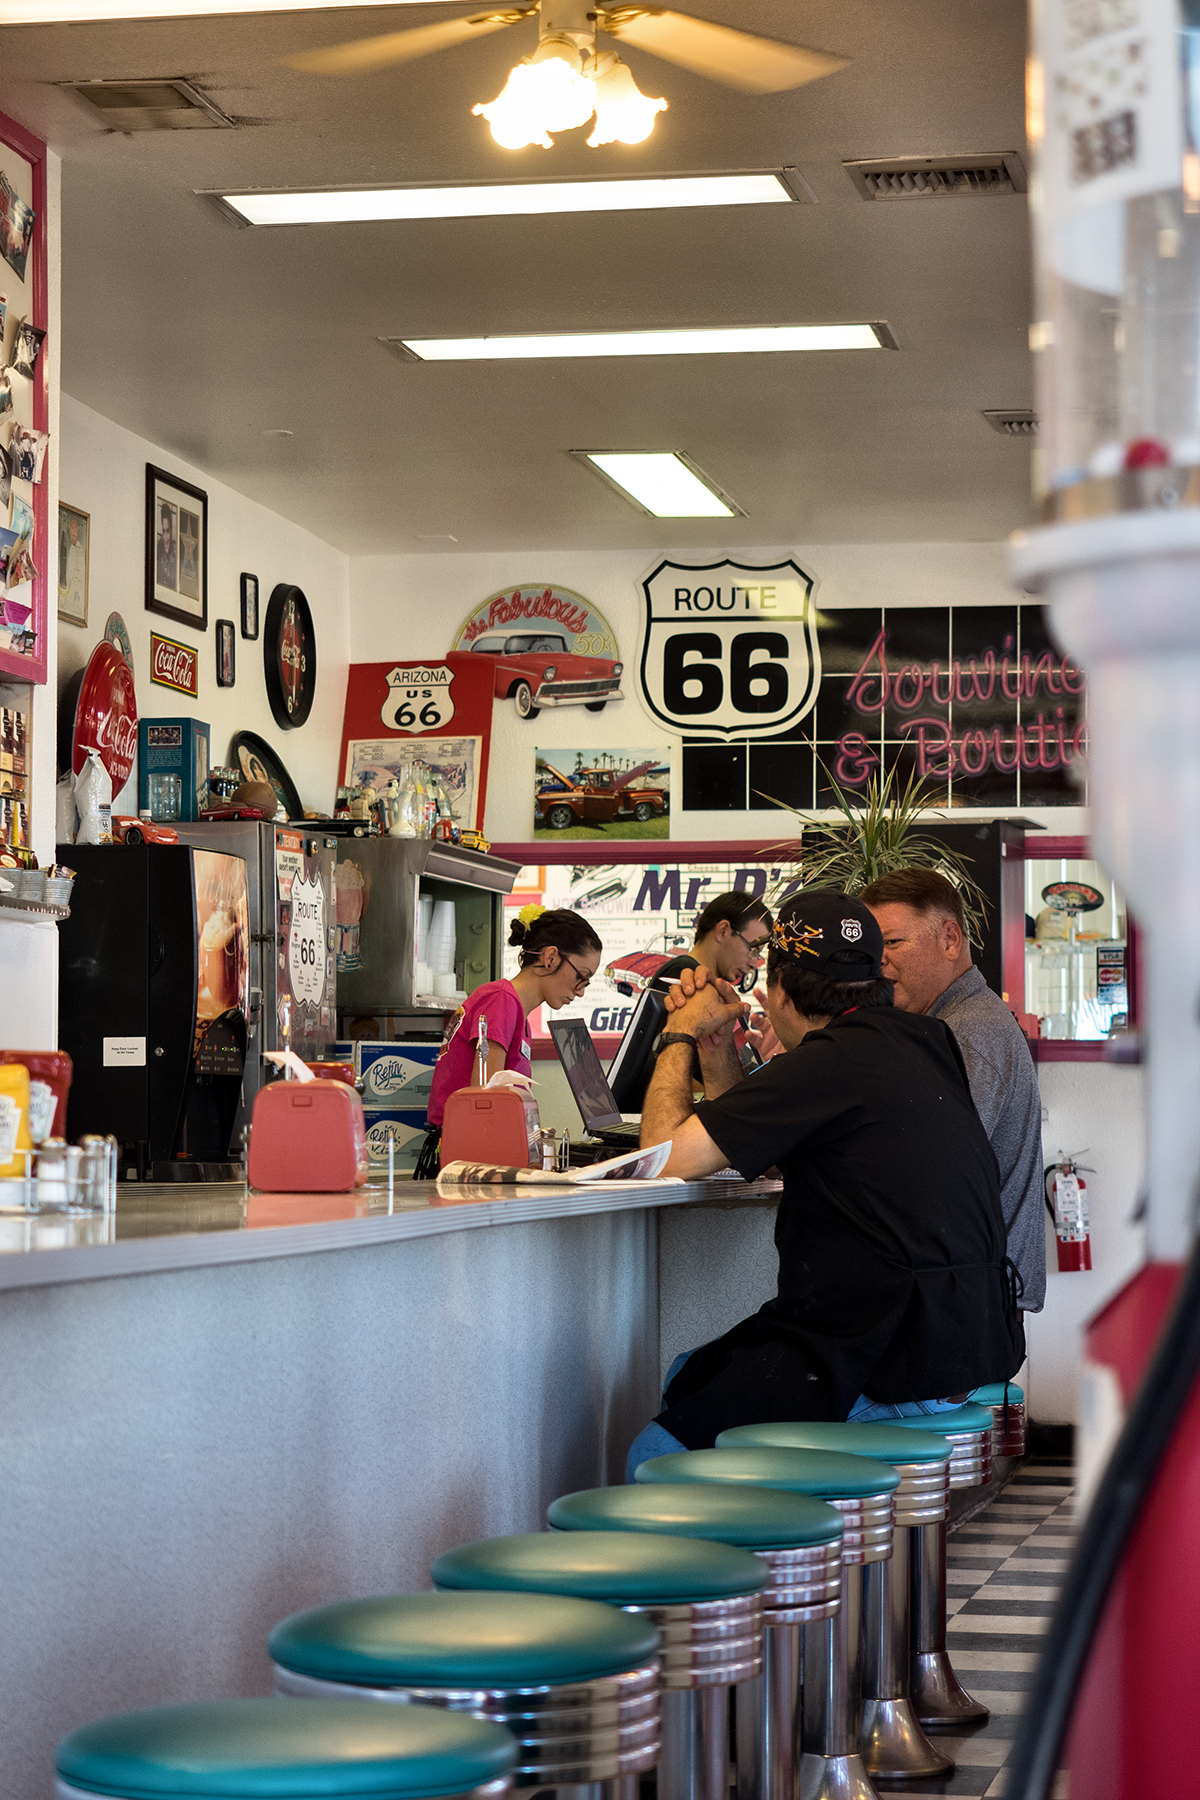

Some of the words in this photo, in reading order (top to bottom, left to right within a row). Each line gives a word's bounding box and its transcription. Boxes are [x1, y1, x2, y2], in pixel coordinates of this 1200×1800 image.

[488, 588, 588, 634] Fabulous
[674, 586, 777, 611] ROUTE
[155, 643, 194, 688] Coca-Cola
[301, 655, 306, 672] 3
[663, 632, 790, 716] 66
[393, 670, 447, 683] ARIZONA
[288, 696, 293, 713] 6
[394, 701, 441, 727] 66
[298, 902, 317, 920] ROUTE
[846, 928, 859, 937] 66
[301, 937, 315, 965] 66
